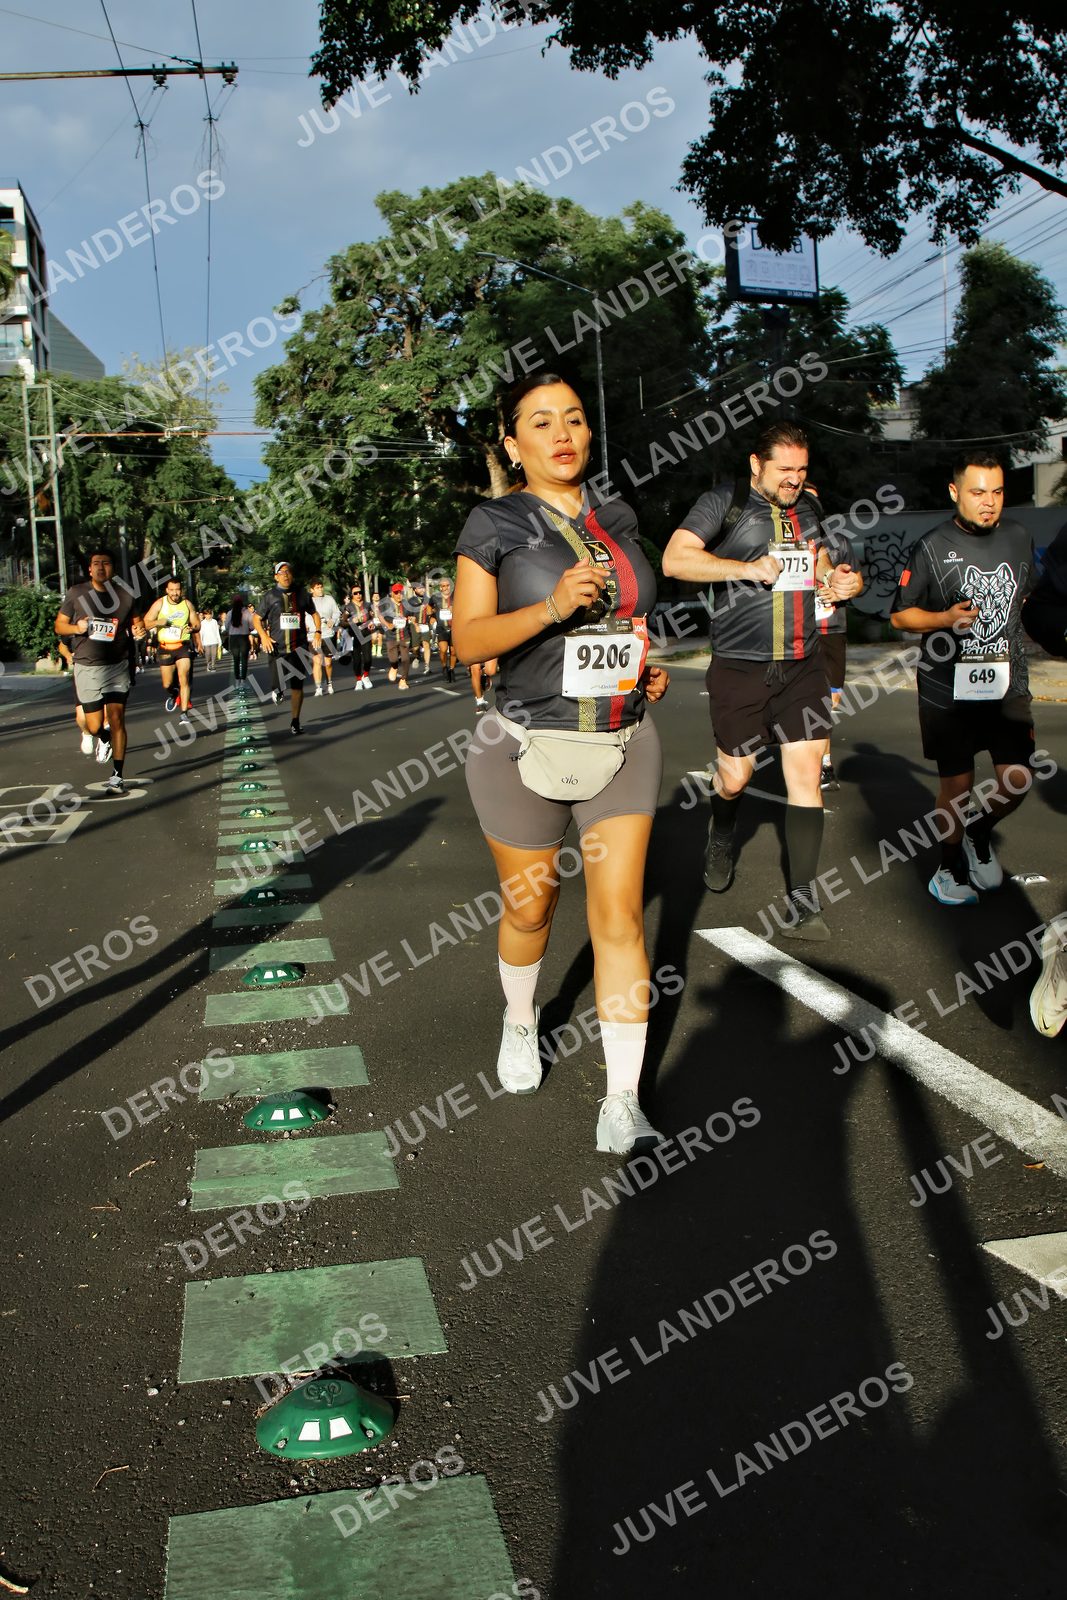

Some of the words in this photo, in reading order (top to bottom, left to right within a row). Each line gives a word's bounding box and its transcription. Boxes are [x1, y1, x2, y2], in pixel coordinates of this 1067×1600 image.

[865, 530, 906, 546] TOY
[577, 644, 631, 670] 9206
[969, 668, 996, 683] 649
